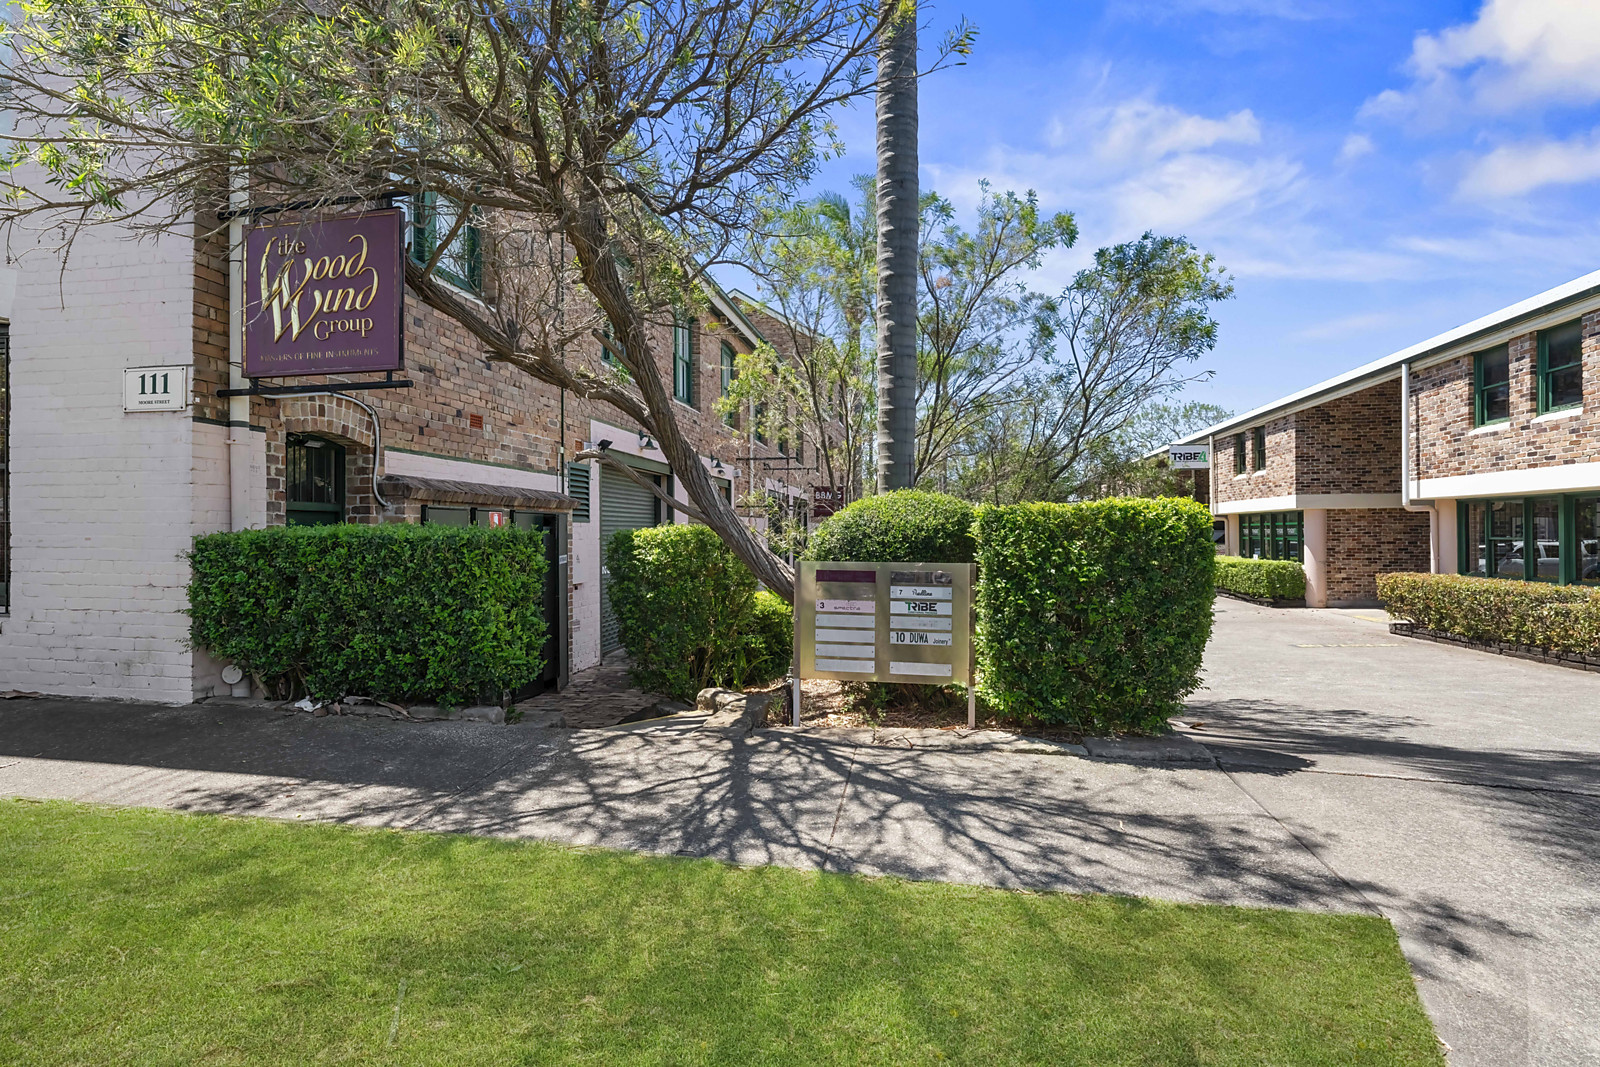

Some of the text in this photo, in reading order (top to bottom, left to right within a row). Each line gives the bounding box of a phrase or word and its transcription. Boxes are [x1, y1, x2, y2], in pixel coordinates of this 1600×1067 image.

[278, 233, 306, 256] the
[260, 234, 368, 310] Wood
[271, 266, 379, 344] Wind
[313, 317, 375, 341] Group
[325, 347, 379, 359] INTRUMNTS
[138, 372, 171, 395] 111
[905, 600, 938, 612] TRIBE
[895, 632, 949, 646] 10 DUWA Joinery
